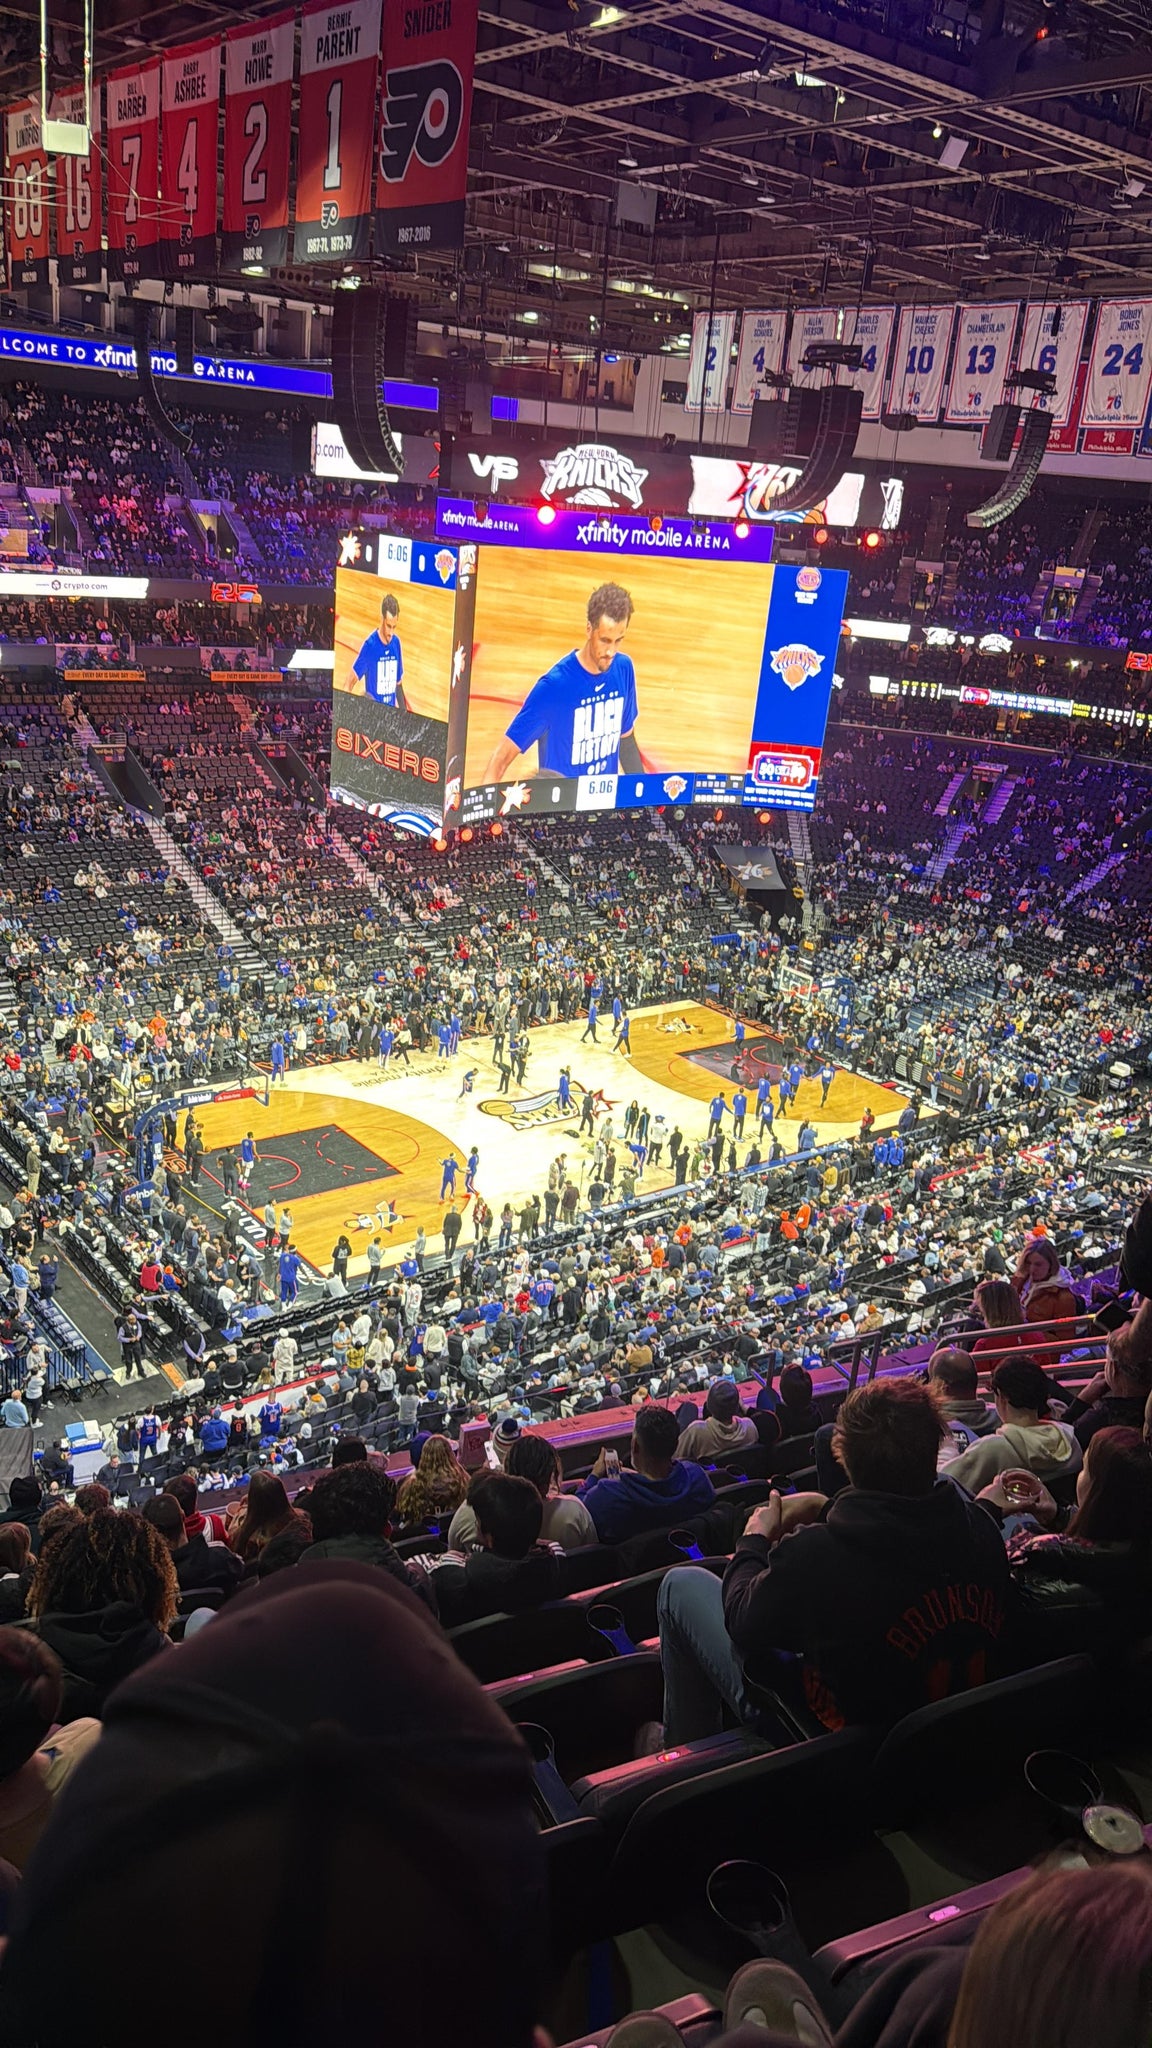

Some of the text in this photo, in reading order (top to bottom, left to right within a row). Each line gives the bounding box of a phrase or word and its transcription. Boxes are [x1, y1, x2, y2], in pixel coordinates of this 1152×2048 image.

[327, 11, 352, 32] BERNIE
[316, 27, 361, 63] PARENT
[245, 54, 273, 85] HOWE
[174, 74, 207, 104] ASHBEE
[118, 95, 147, 121] BARBER
[323, 79, 343, 191] 1
[178, 118, 199, 214] 4
[242, 101, 268, 205] 2
[65, 153, 91, 232] 16
[122, 135, 142, 225] 7
[13, 159, 43, 239] 88
[857, 315, 879, 324] CHARLES
[914, 315, 938, 324] MAURICE
[980, 313, 993, 323] WILT
[1117, 320, 1140, 332] JONES
[1119, 308, 1143, 320] BOBBY
[803, 326, 824, 336] IVERSON
[914, 325, 935, 335] CHEEKS
[967, 323, 1006, 335] CHAMBERLAIN
[66, 346, 86, 360] TO
[94, 344, 138, 367] xfinit
[206, 362, 256, 382] ARENA
[705, 346, 717, 371] 2
[752, 346, 766, 373] 4
[906, 346, 935, 374] 10
[965, 345, 997, 374] 13
[1038, 344, 1058, 373] 6
[1102, 343, 1144, 376] 24
[967, 392, 982, 406] 76
[1033, 393, 1047, 409] 76
[1107, 394, 1121, 410] 76
[950, 409, 981, 417] Philadelphia
[578, 449, 616, 461] NEW YORK
[550, 457, 637, 497] KNICKS
[442, 509, 467, 528] xfinity
[493, 520, 519, 532] ARENA
[576, 522, 730, 549] xfinity mobile ARENA
[336, 727, 440, 783] SIXERS
[125, 1188, 156, 1202] coinba
